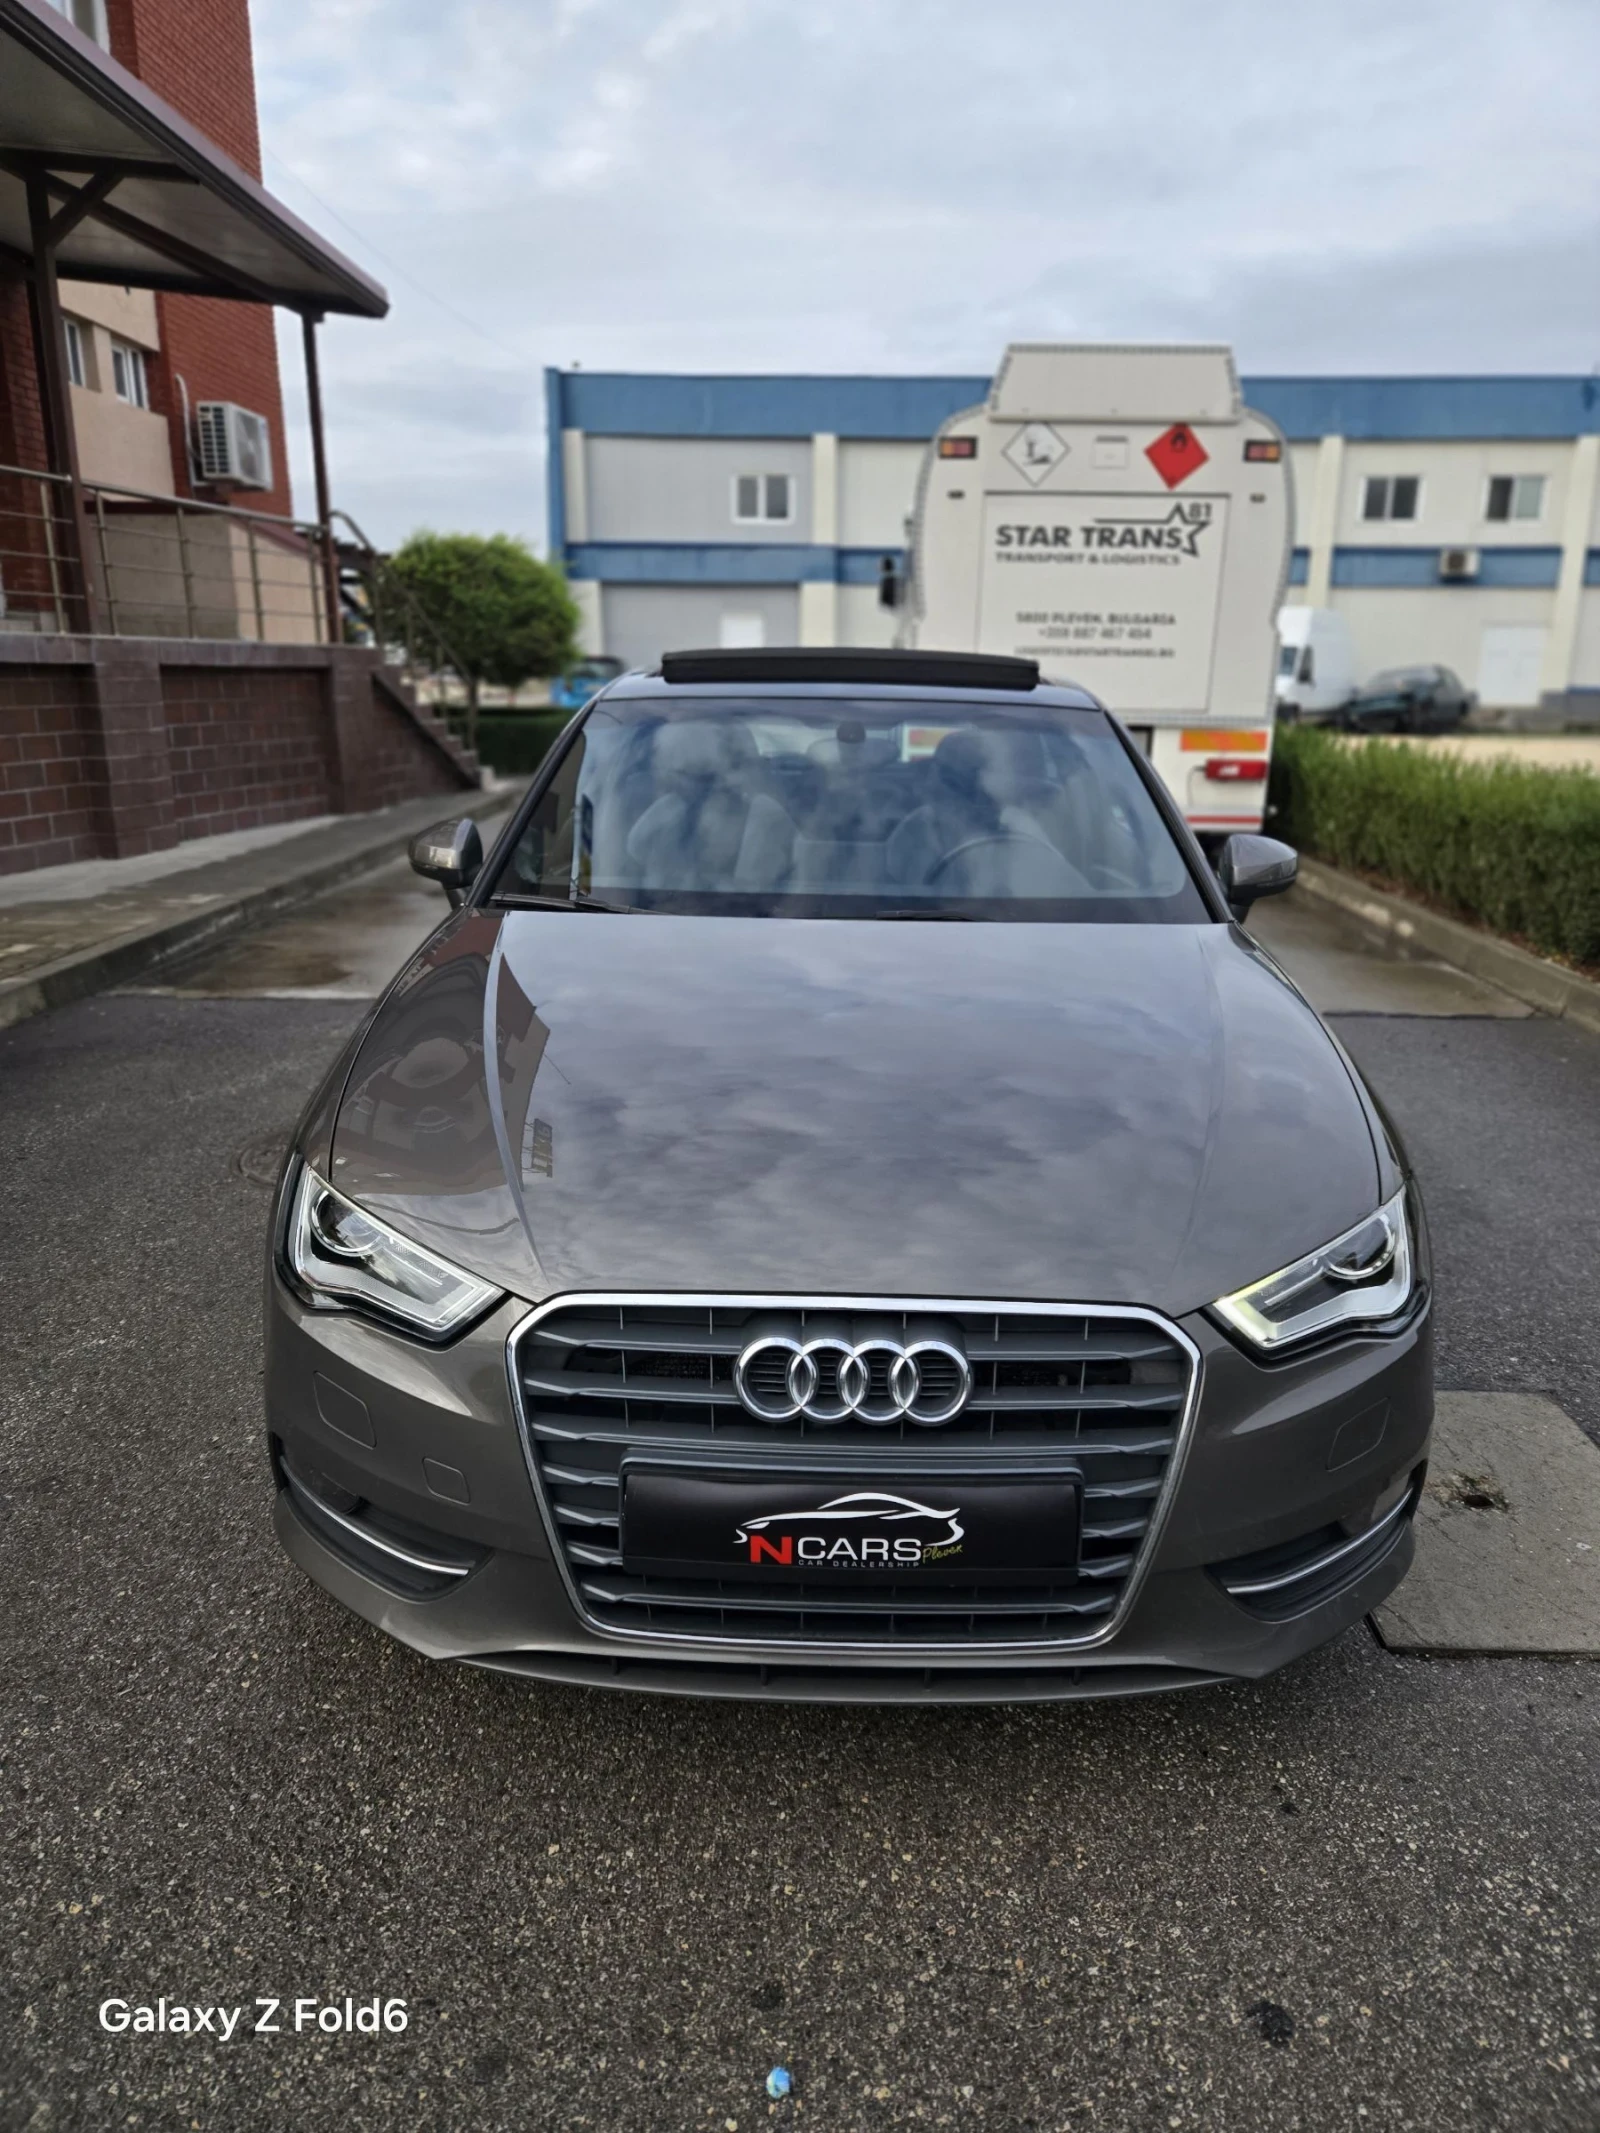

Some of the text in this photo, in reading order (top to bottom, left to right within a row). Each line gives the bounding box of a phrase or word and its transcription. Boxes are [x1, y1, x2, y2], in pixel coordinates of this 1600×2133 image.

[1188, 502, 1212, 519] 81
[995, 525, 1182, 549] STAR TRANS
[996, 552, 1084, 565] TRANSPORT
[1102, 553, 1180, 566] LOGISTICS
[799, 1559, 919, 1568] CAR DEALERSHIP
